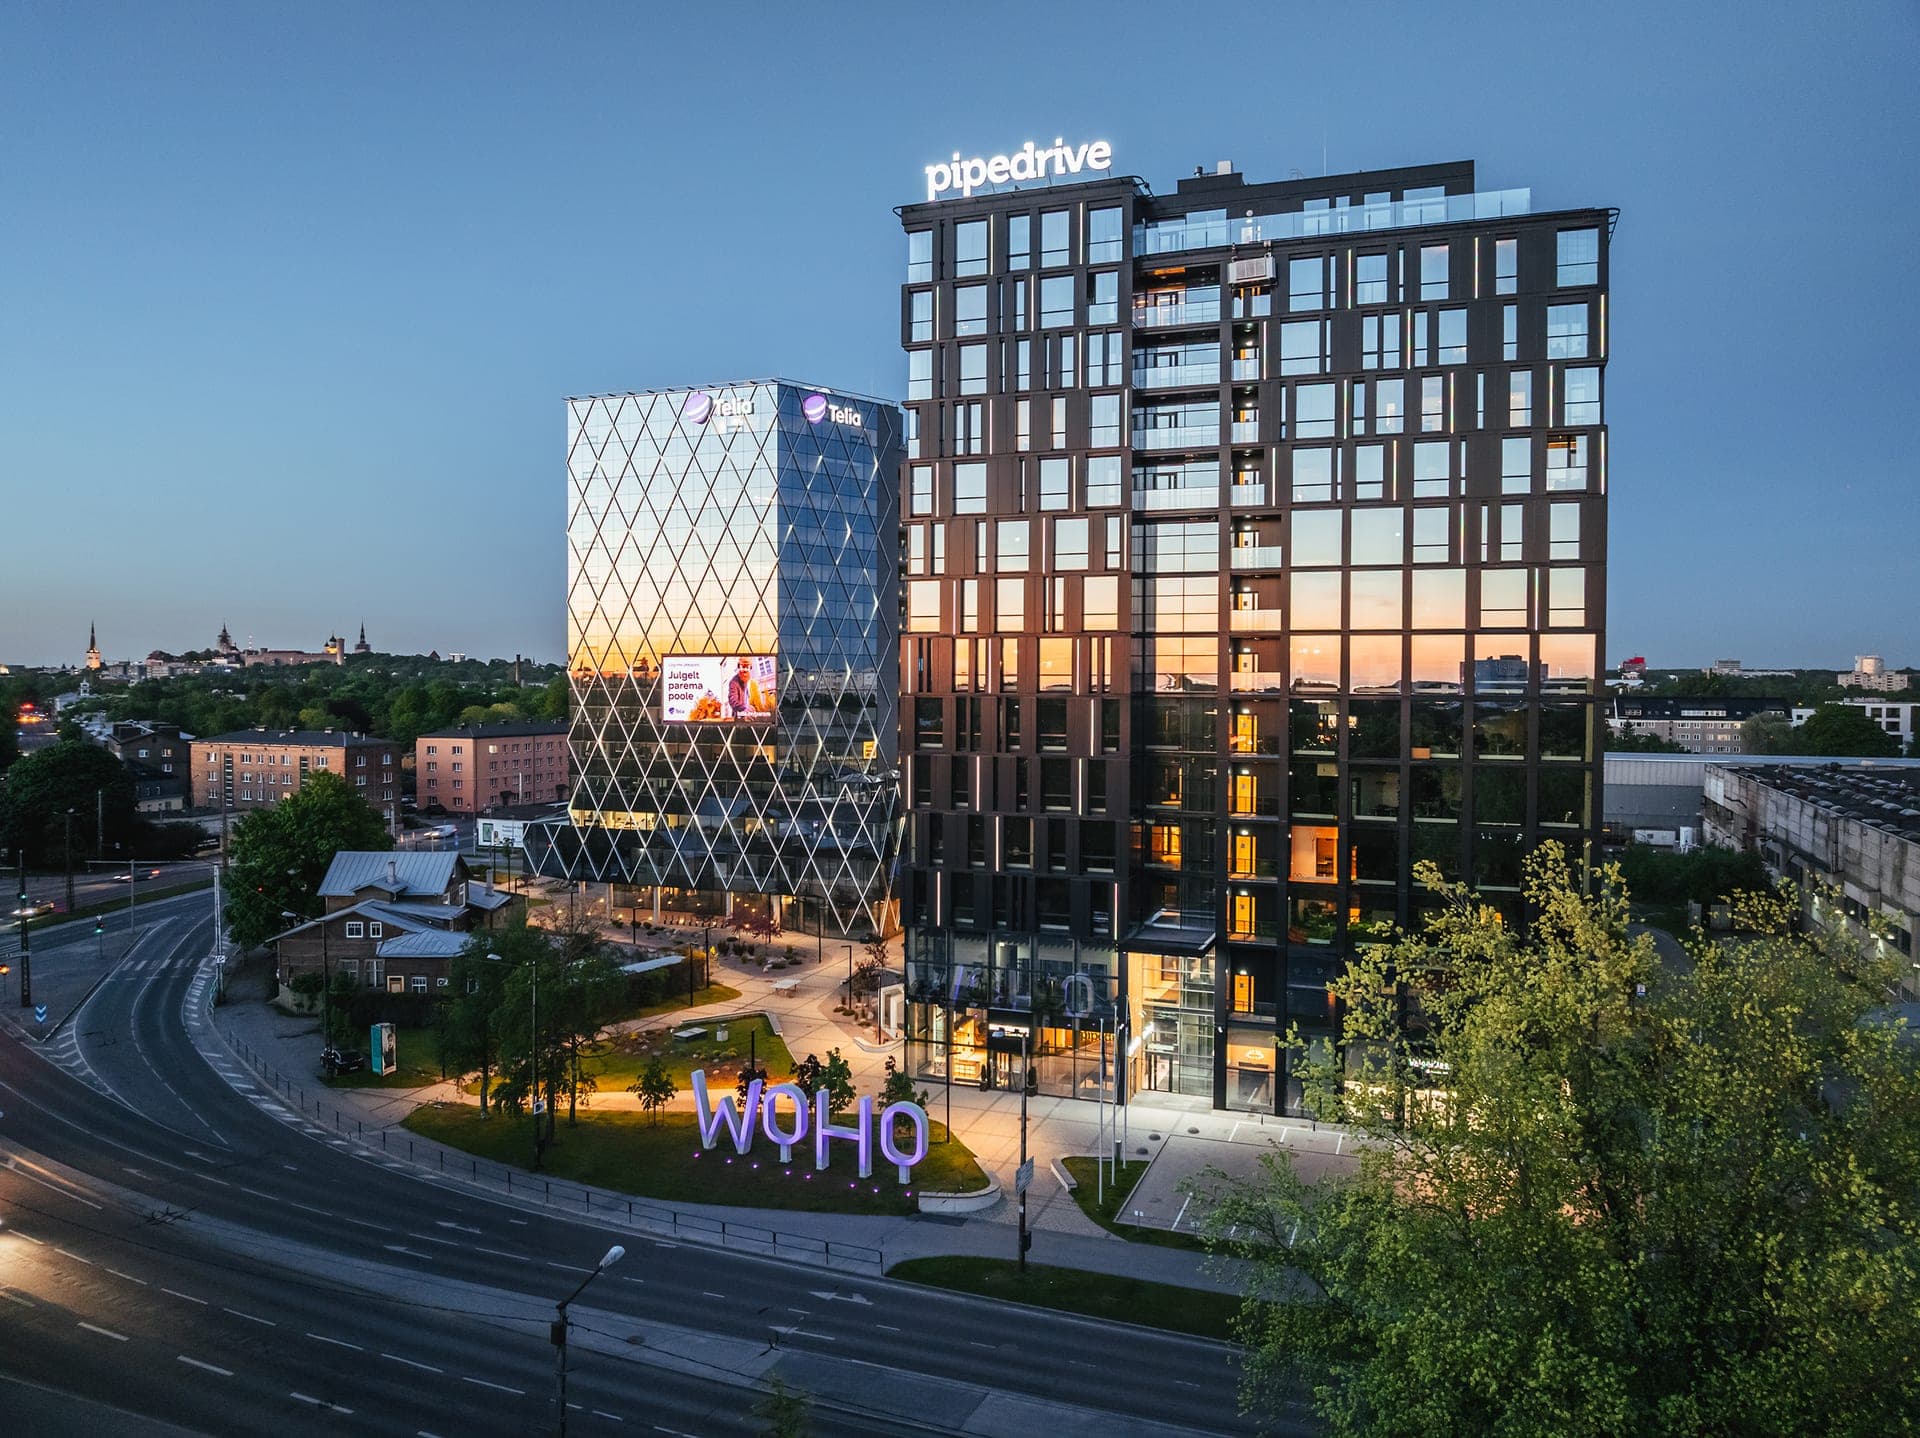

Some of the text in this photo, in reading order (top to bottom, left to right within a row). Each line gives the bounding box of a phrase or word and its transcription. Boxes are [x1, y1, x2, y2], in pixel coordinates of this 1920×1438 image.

[925, 137, 1112, 201] pipedrive
[713, 398, 753, 416] Telia
[829, 404, 861, 426] Telia
[668, 671, 700, 681] Julgelt
[668, 682, 703, 691] parema
[668, 692, 694, 702] poole
[690, 1069, 929, 1184] WOHO
